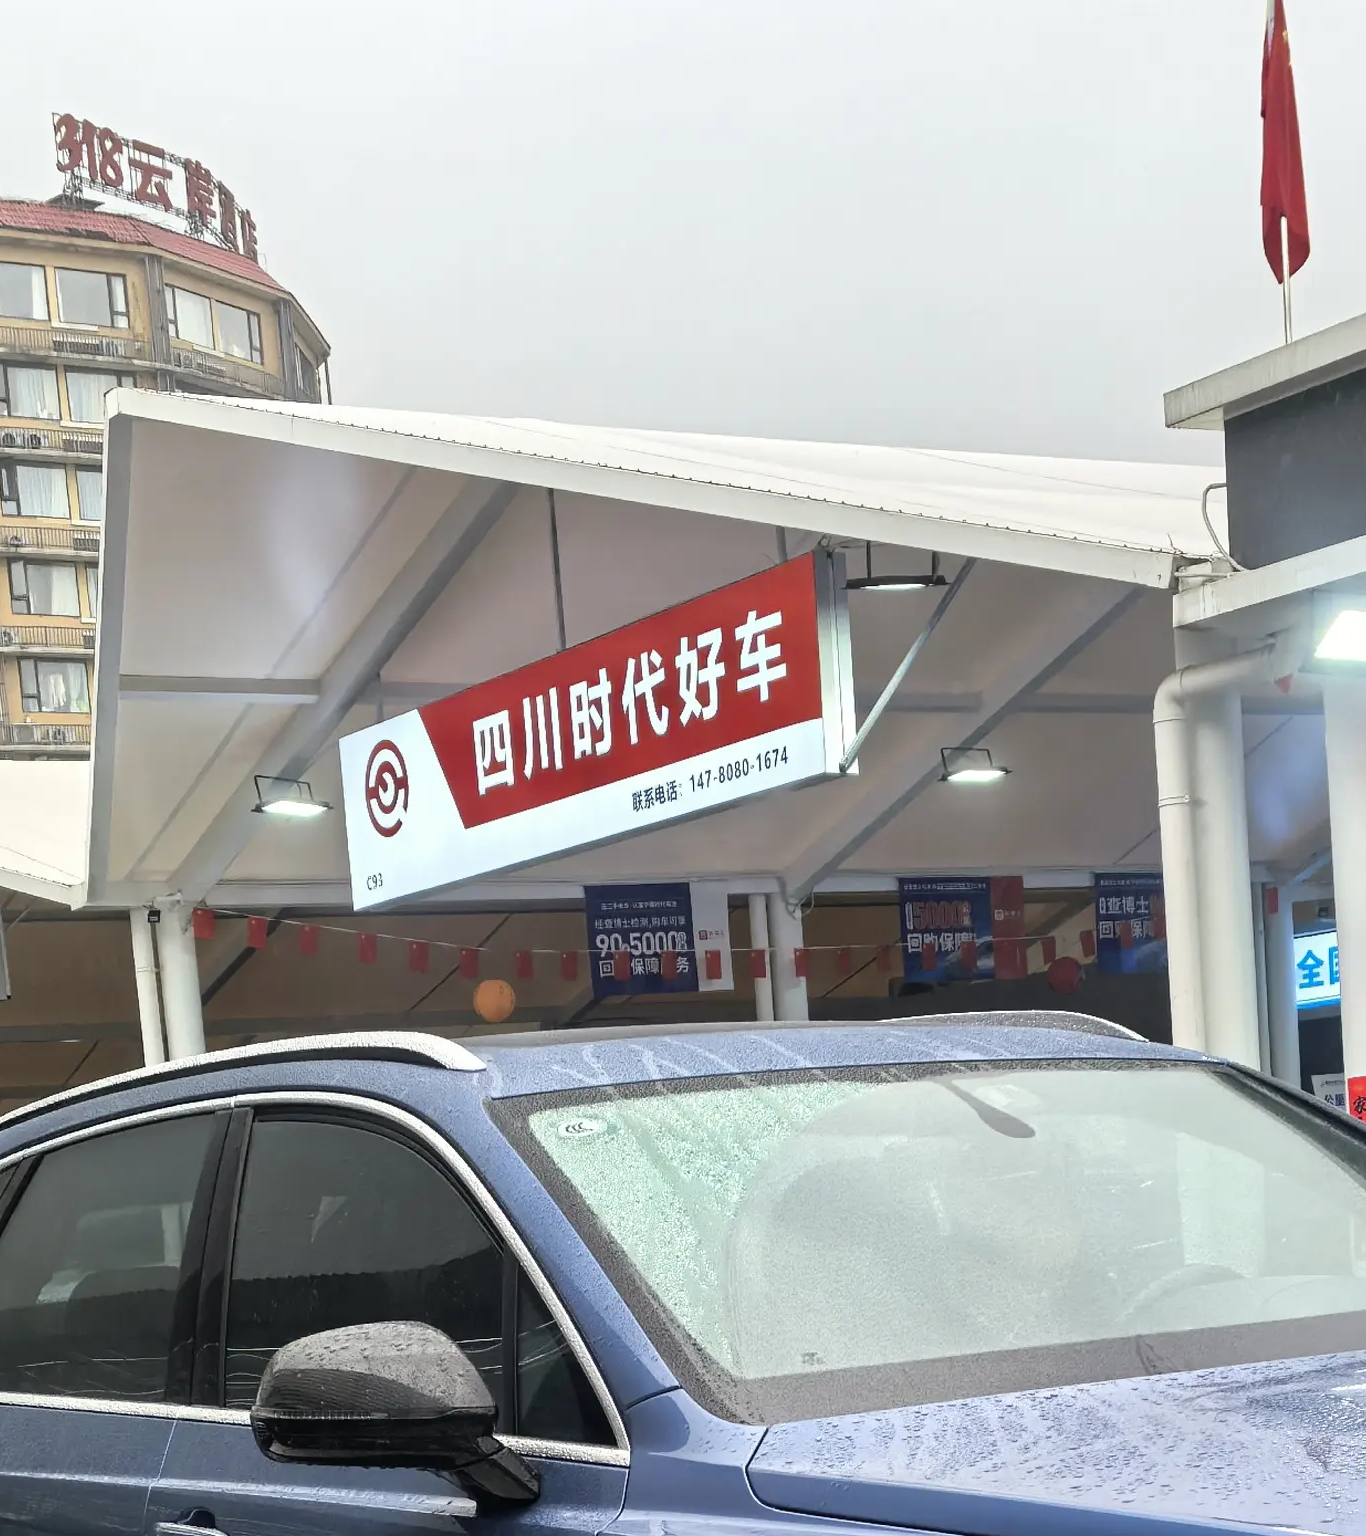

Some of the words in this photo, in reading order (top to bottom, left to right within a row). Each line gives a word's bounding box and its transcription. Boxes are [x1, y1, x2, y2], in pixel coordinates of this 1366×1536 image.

[472, 609, 788, 795] 四川时代好车
